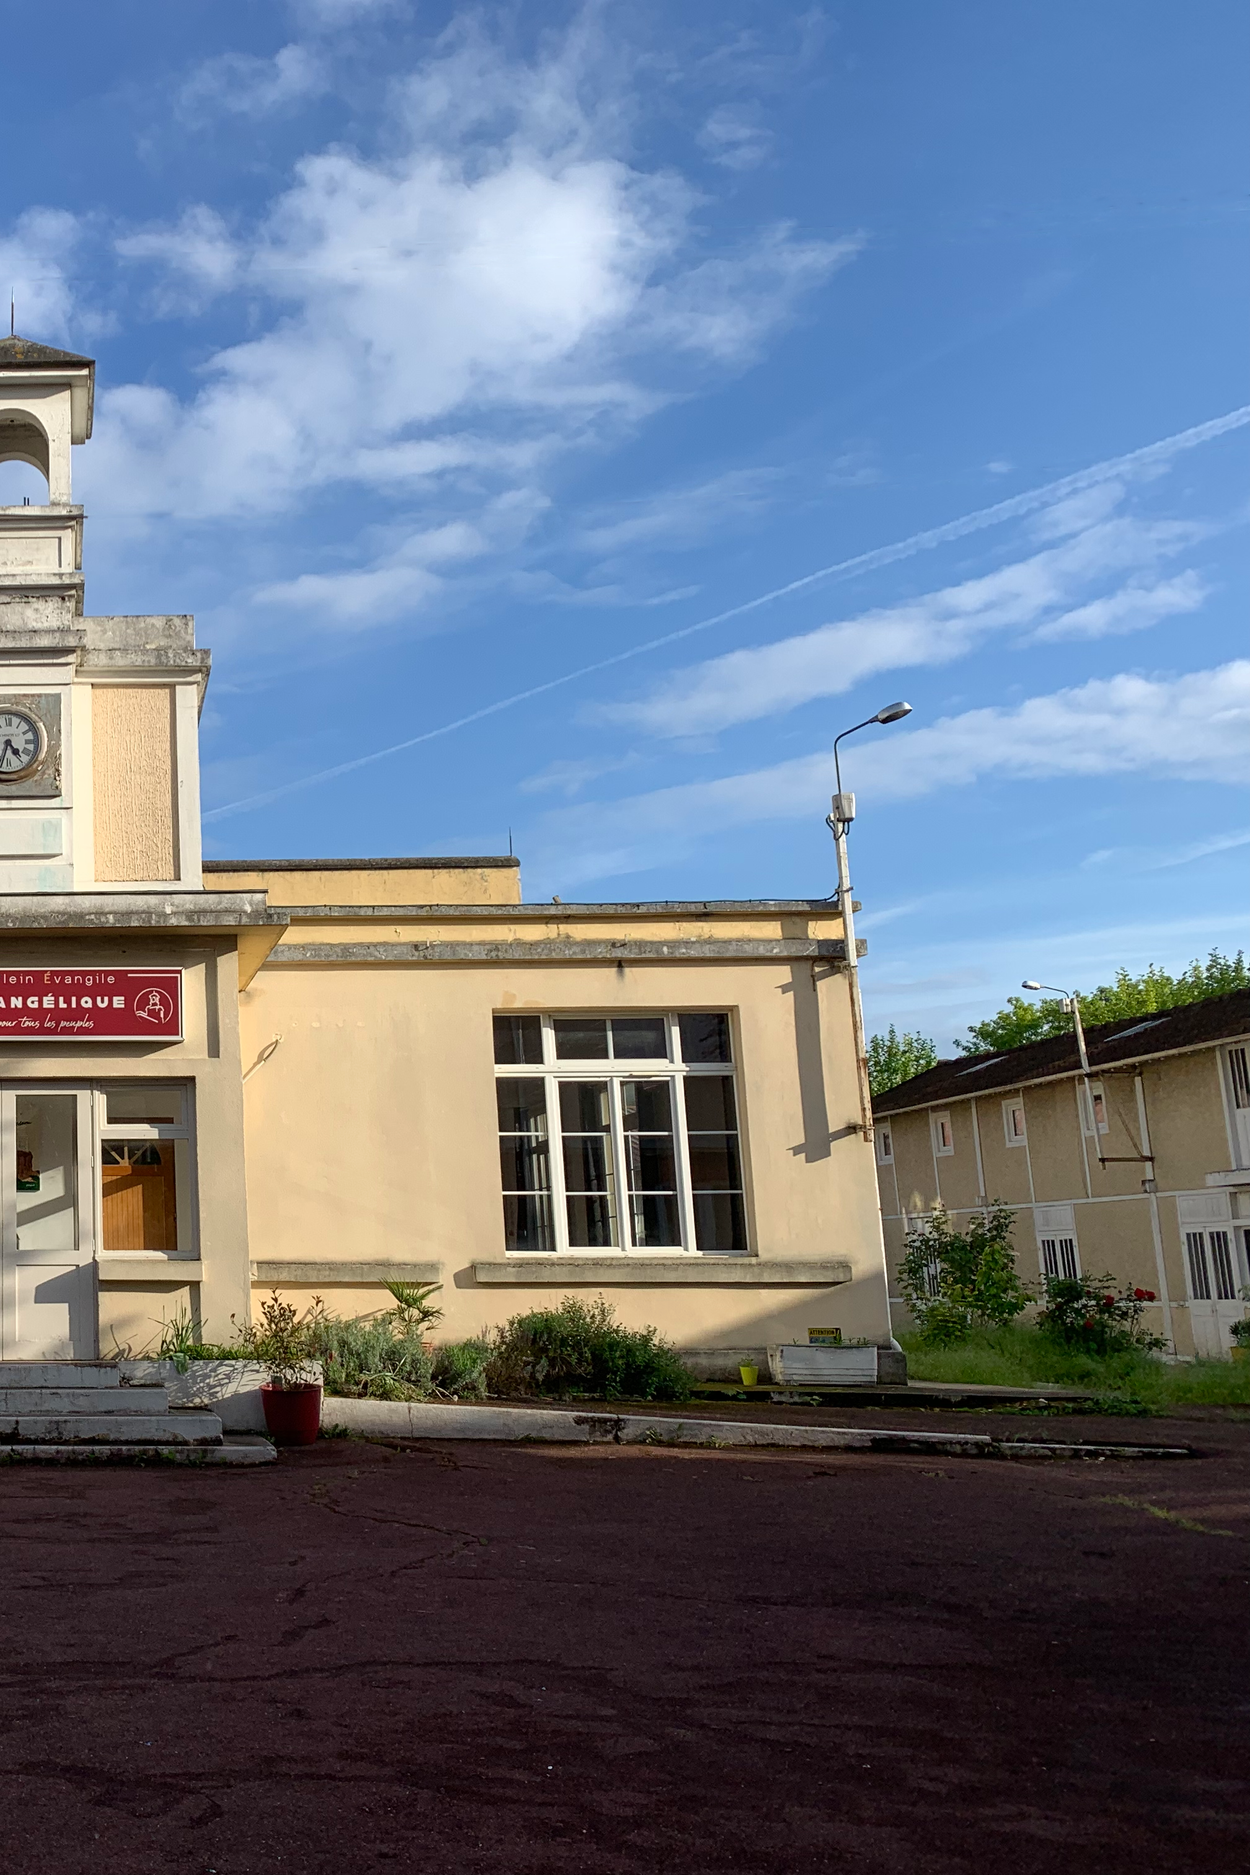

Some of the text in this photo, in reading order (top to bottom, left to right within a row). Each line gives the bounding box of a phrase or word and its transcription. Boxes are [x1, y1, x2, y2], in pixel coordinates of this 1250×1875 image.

[44, 971, 116, 987] Évangile
[18, 1015, 41, 1028] tous
[44, 1013, 56, 1029] les
[57, 1013, 94, 1032] peuples
